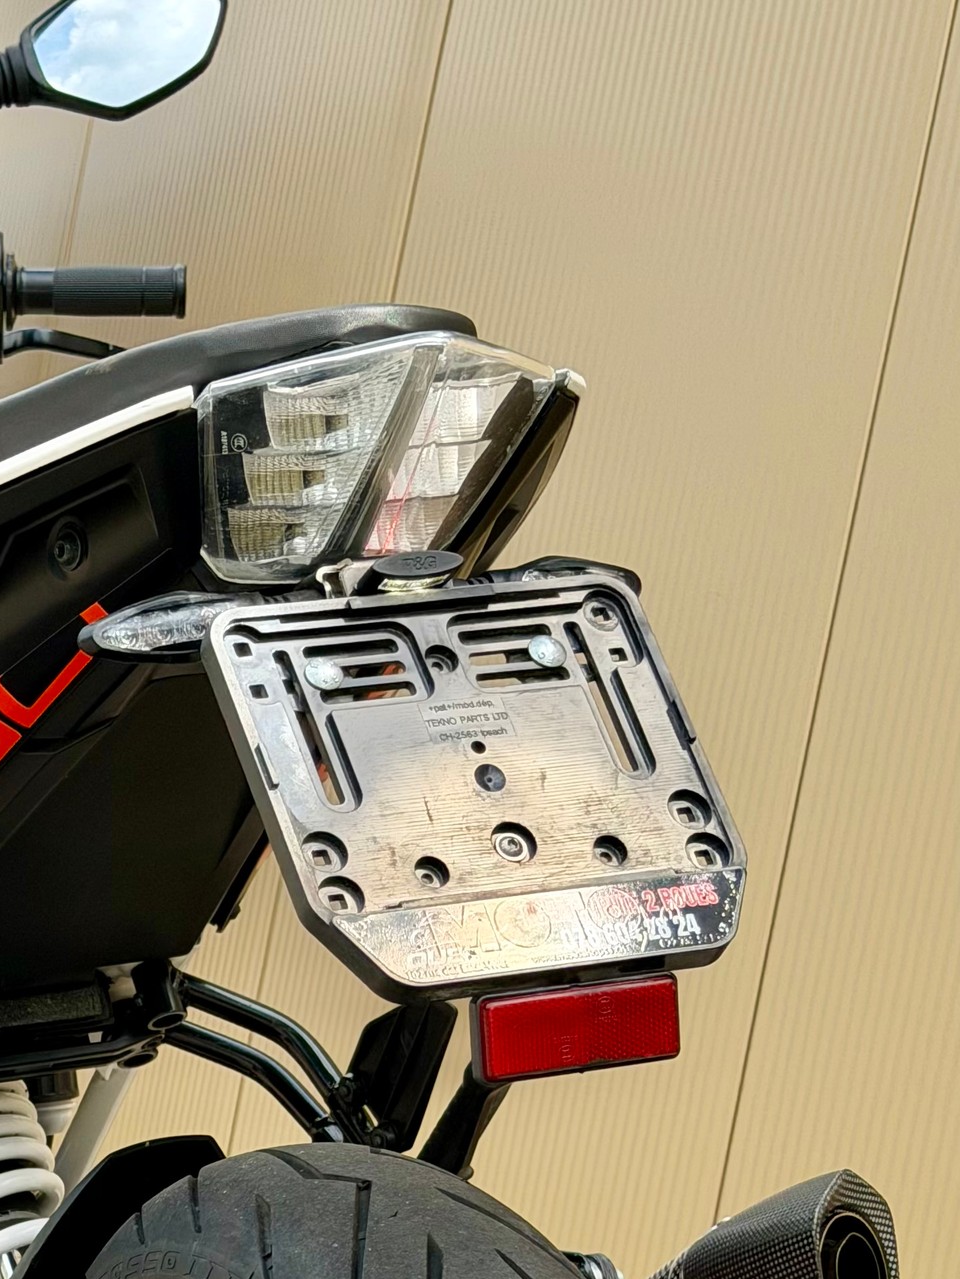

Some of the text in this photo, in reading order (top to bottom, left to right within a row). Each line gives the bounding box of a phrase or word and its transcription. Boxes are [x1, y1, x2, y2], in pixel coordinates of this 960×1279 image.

[425, 711, 509, 728] TEKNO PARTS LTD
[641, 890, 660, 912] 2
[659, 883, 720, 911] ROUES
[673, 913, 701, 937] 24
